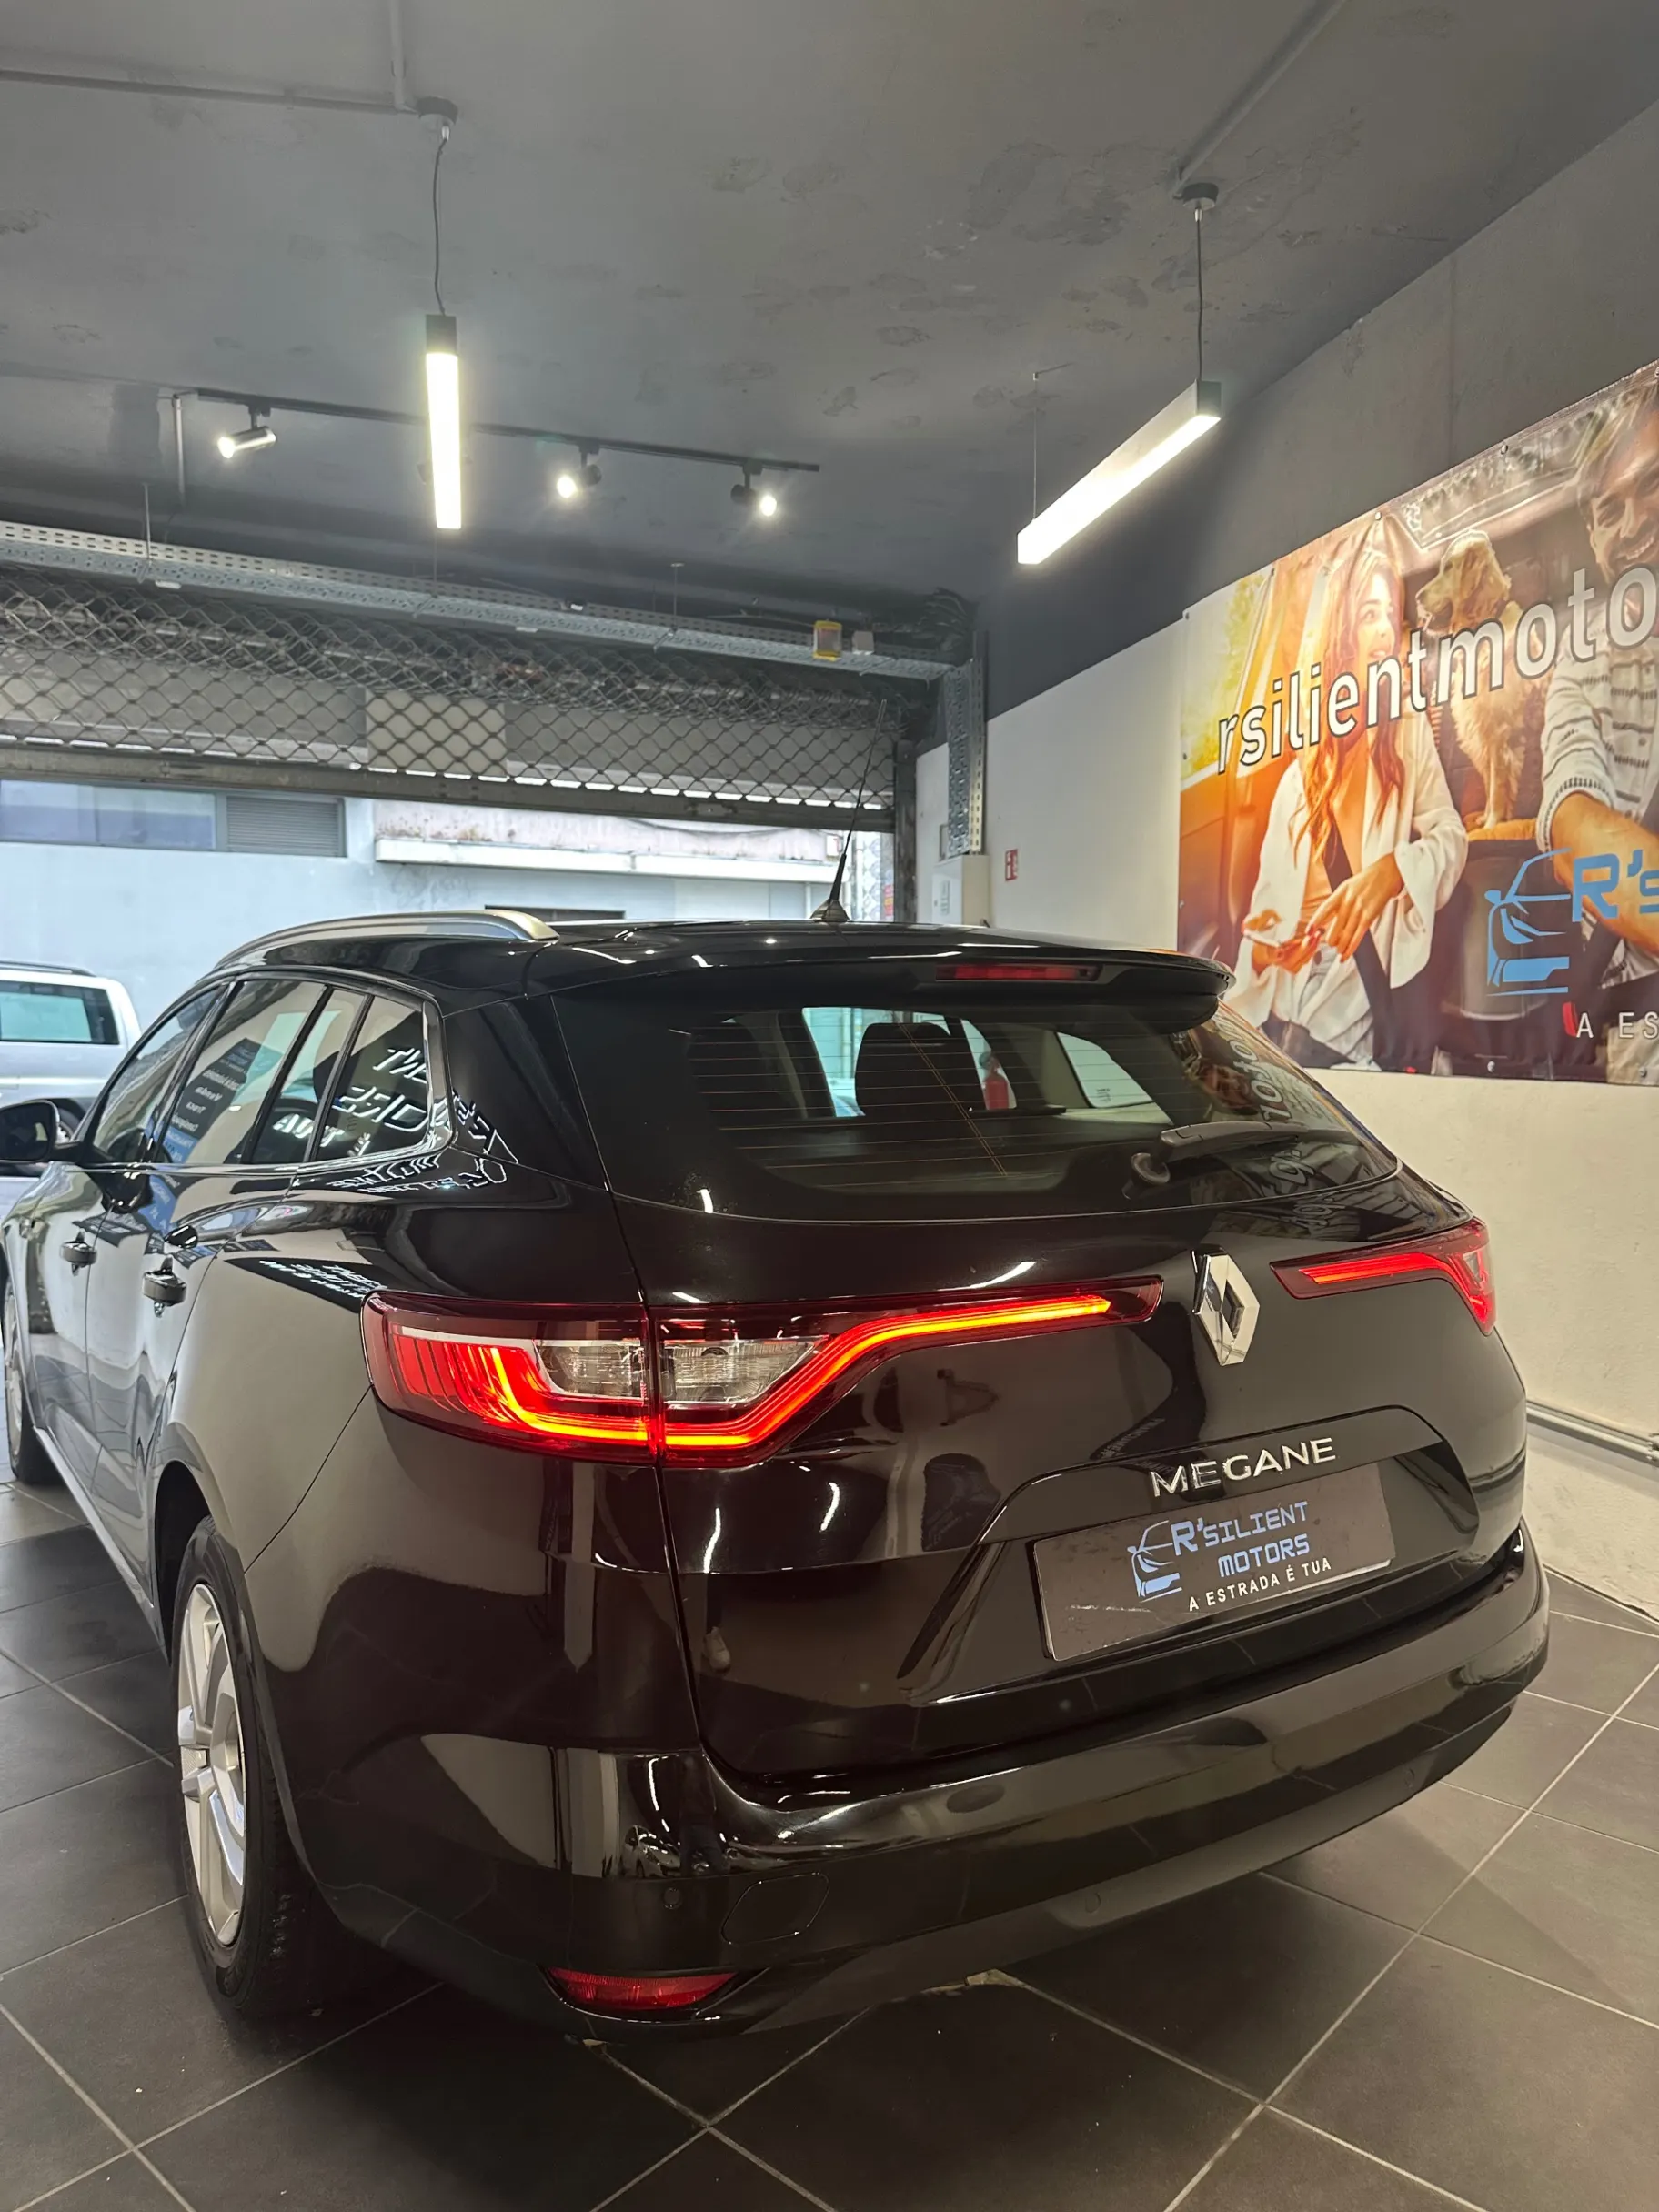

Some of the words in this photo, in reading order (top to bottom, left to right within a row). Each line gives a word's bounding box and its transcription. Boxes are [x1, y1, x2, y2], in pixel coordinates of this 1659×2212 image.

[1217, 563, 1659, 774] rsilientmoto
[1576, 1012, 1594, 1038] A
[1619, 1011, 1658, 1039] ES
[1151, 1437, 1336, 1497] MEGANE
[1171, 1501, 1308, 1556] R'SILIENT
[1218, 1533, 1310, 1578] MOTORS
[1189, 1597, 1199, 1612] A
[1206, 1573, 1280, 1606] ESTRADA
[1286, 1564, 1295, 1583] É
[1302, 1557, 1332, 1577] TUA
